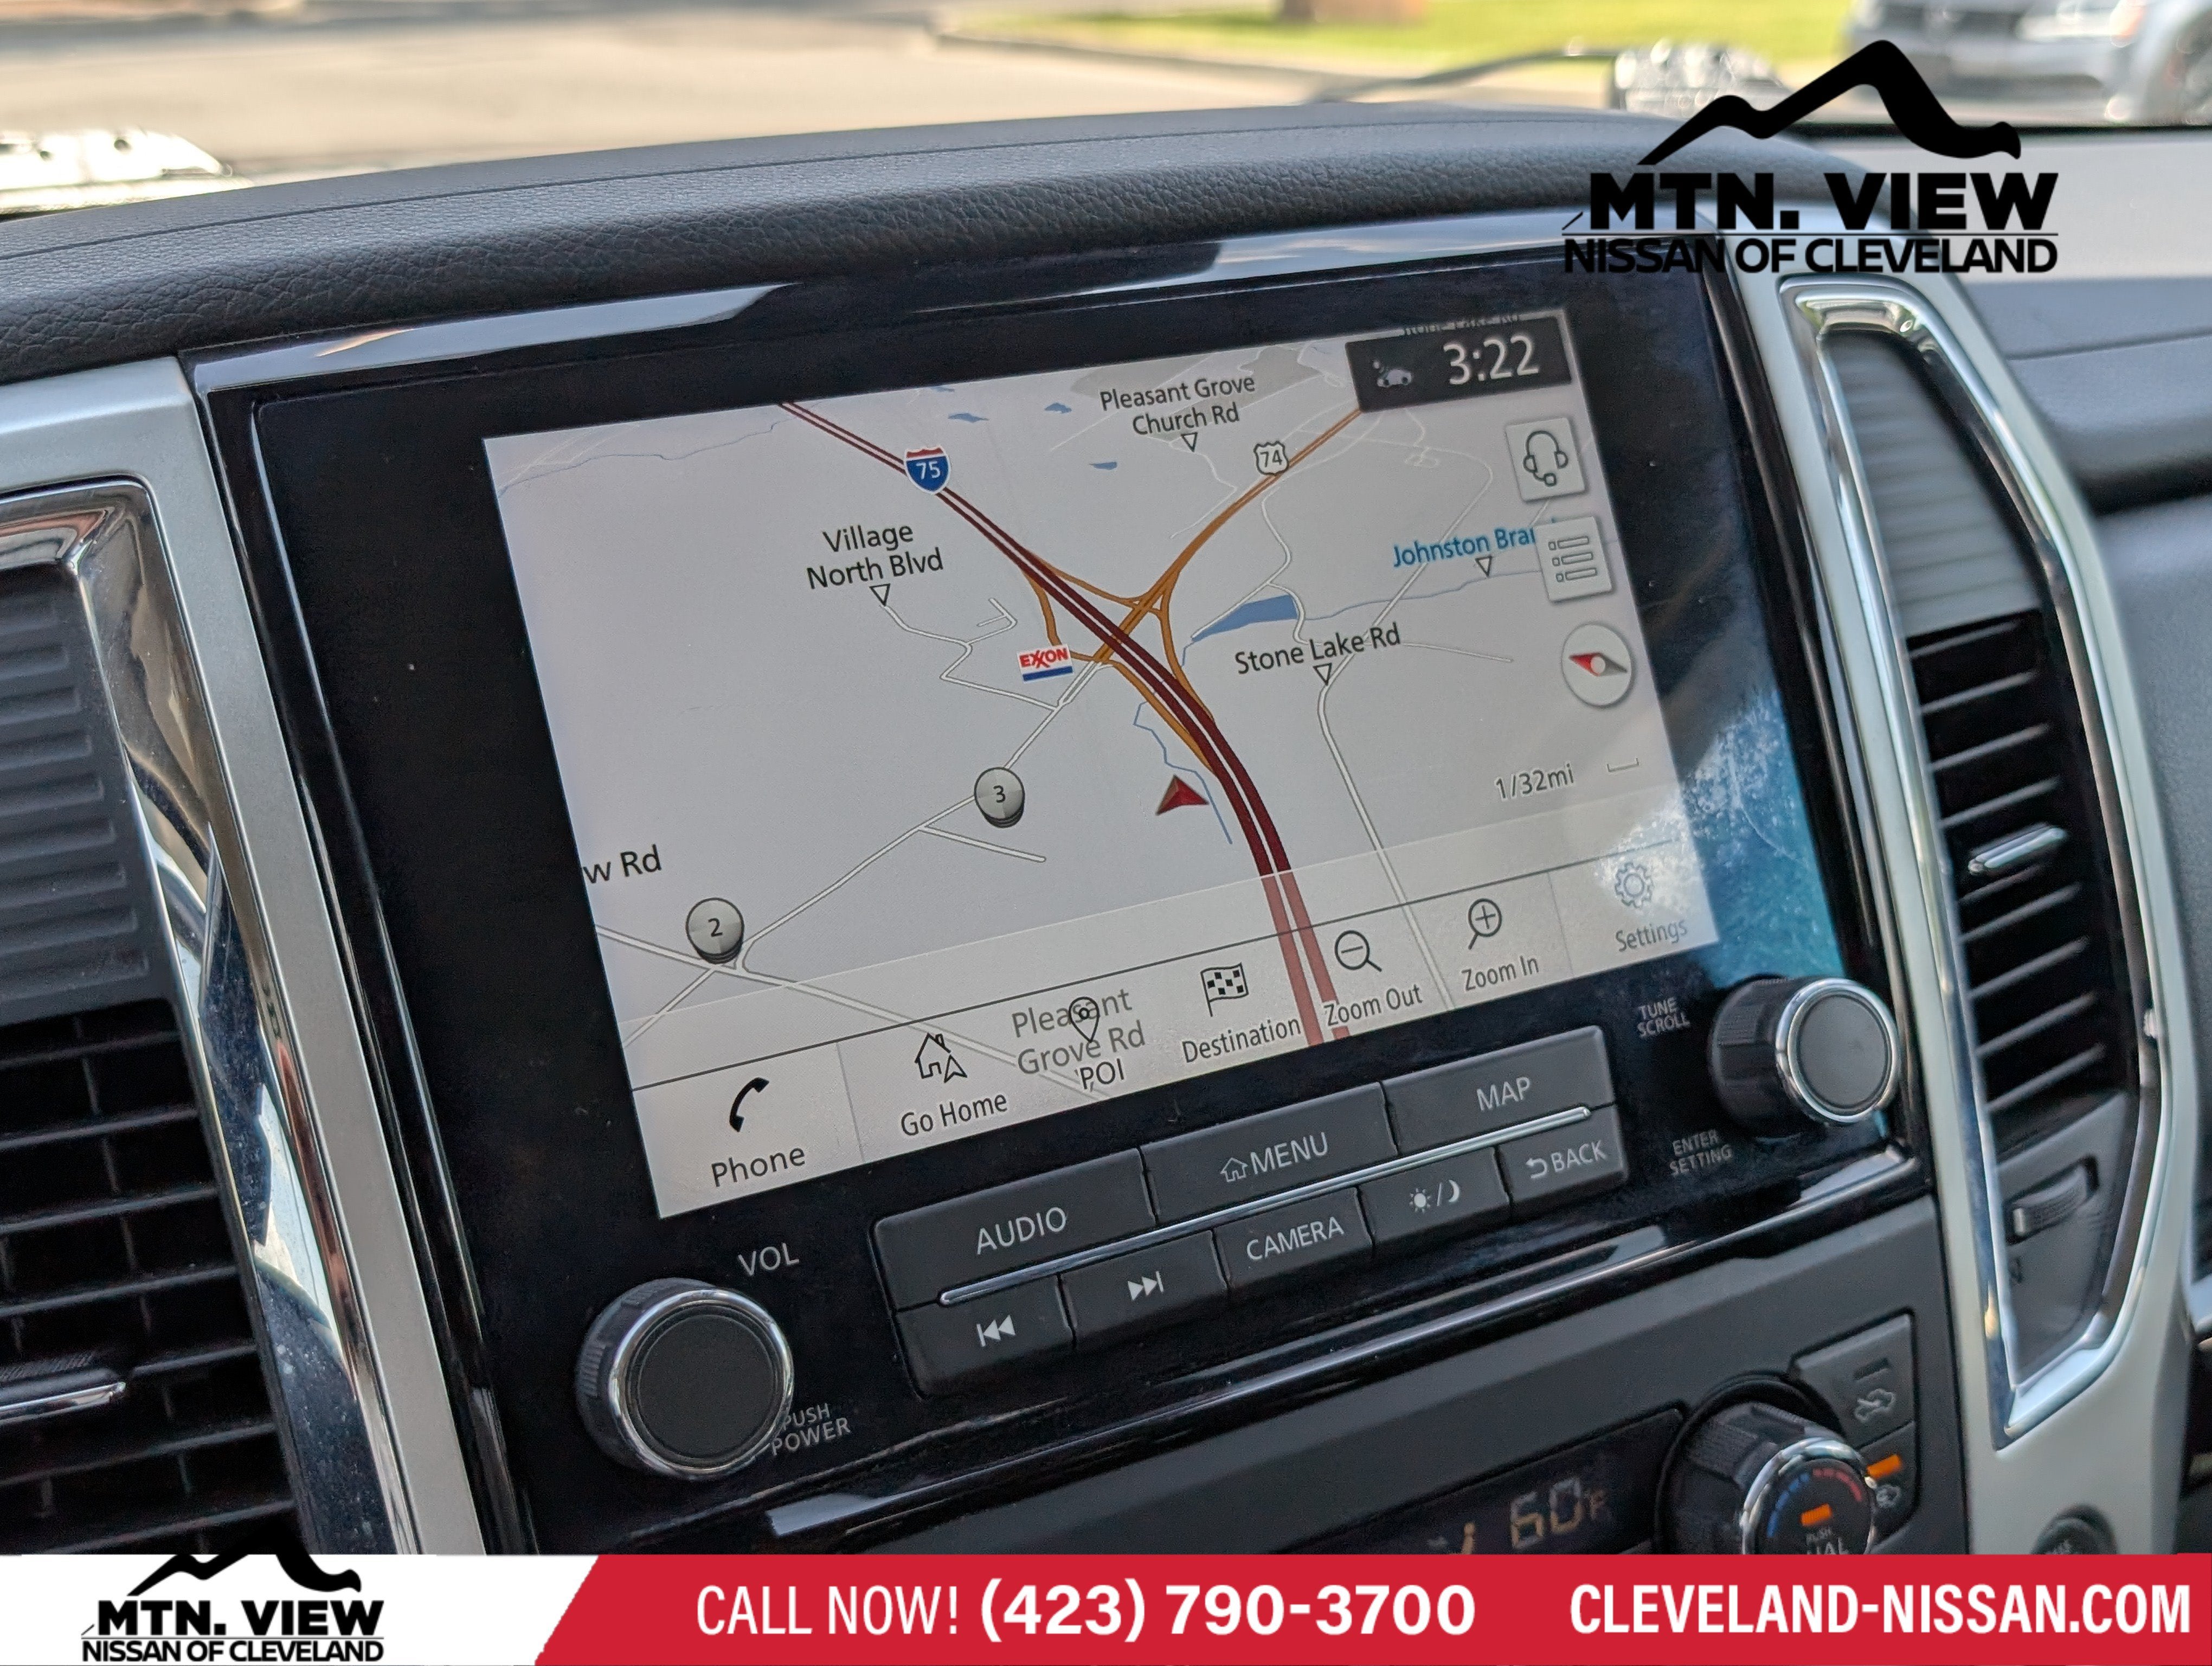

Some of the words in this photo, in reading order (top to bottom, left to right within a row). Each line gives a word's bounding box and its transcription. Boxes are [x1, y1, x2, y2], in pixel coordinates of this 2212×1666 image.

[1442, 333, 1540, 385] 3:22
[1099, 382, 1191, 412] Pleasant
[1193, 377, 1255, 398] Grove
[1132, 407, 1206, 436] Church
[1211, 402, 1240, 425] Rd
[915, 460, 941, 480] 75
[1259, 450, 1283, 467] 74
[822, 524, 914, 550] Village
[1393, 535, 1490, 568] Johnston
[806, 558, 884, 589] North
[889, 547, 943, 577] Blvd
[1019, 646, 1070, 669] EXXON
[1234, 646, 1304, 675] Stone
[1311, 631, 1365, 661] Lake
[1369, 622, 1401, 649] Rd
[993, 785, 1006, 804] 3
[1496, 763, 1574, 798] 1/32mi
[582, 861, 612, 885] w
[619, 844, 662, 877] Rd
[708, 918, 723, 938] 2
[1615, 918, 1688, 953] Settings
[1461, 963, 1516, 991] Zoom
[1520, 956, 1539, 976] In
[1011, 988, 1133, 1039] Pleasant
[1323, 998, 1380, 1027] Zoom
[1386, 984, 1423, 1010] Out
[1638, 997, 1678, 1017] TUNE
[1181, 1016, 1301, 1063] Destination
[1637, 1013, 1690, 1038] SCROLL
[1017, 1039, 1102, 1075] Grove
[1107, 1018, 1146, 1054] Rd
[1080, 1058, 1126, 1090] POI
[1476, 1077, 1531, 1111] MAP
[901, 1112, 934, 1136] Go
[940, 1094, 1008, 1127] Home
[1250, 1132, 1328, 1175] MENU
[1551, 1140, 1606, 1172] BACK
[1672, 1130, 1720, 1157] ENTER
[711, 1148, 806, 1188] Phone
[1669, 1146, 1733, 1177] SETTING
[977, 1207, 1067, 1255] AUDIO
[1246, 1216, 1345, 1261] CAMERA
[738, 1242, 800, 1276] VOL
[771, 1417, 851, 1457] POWER
